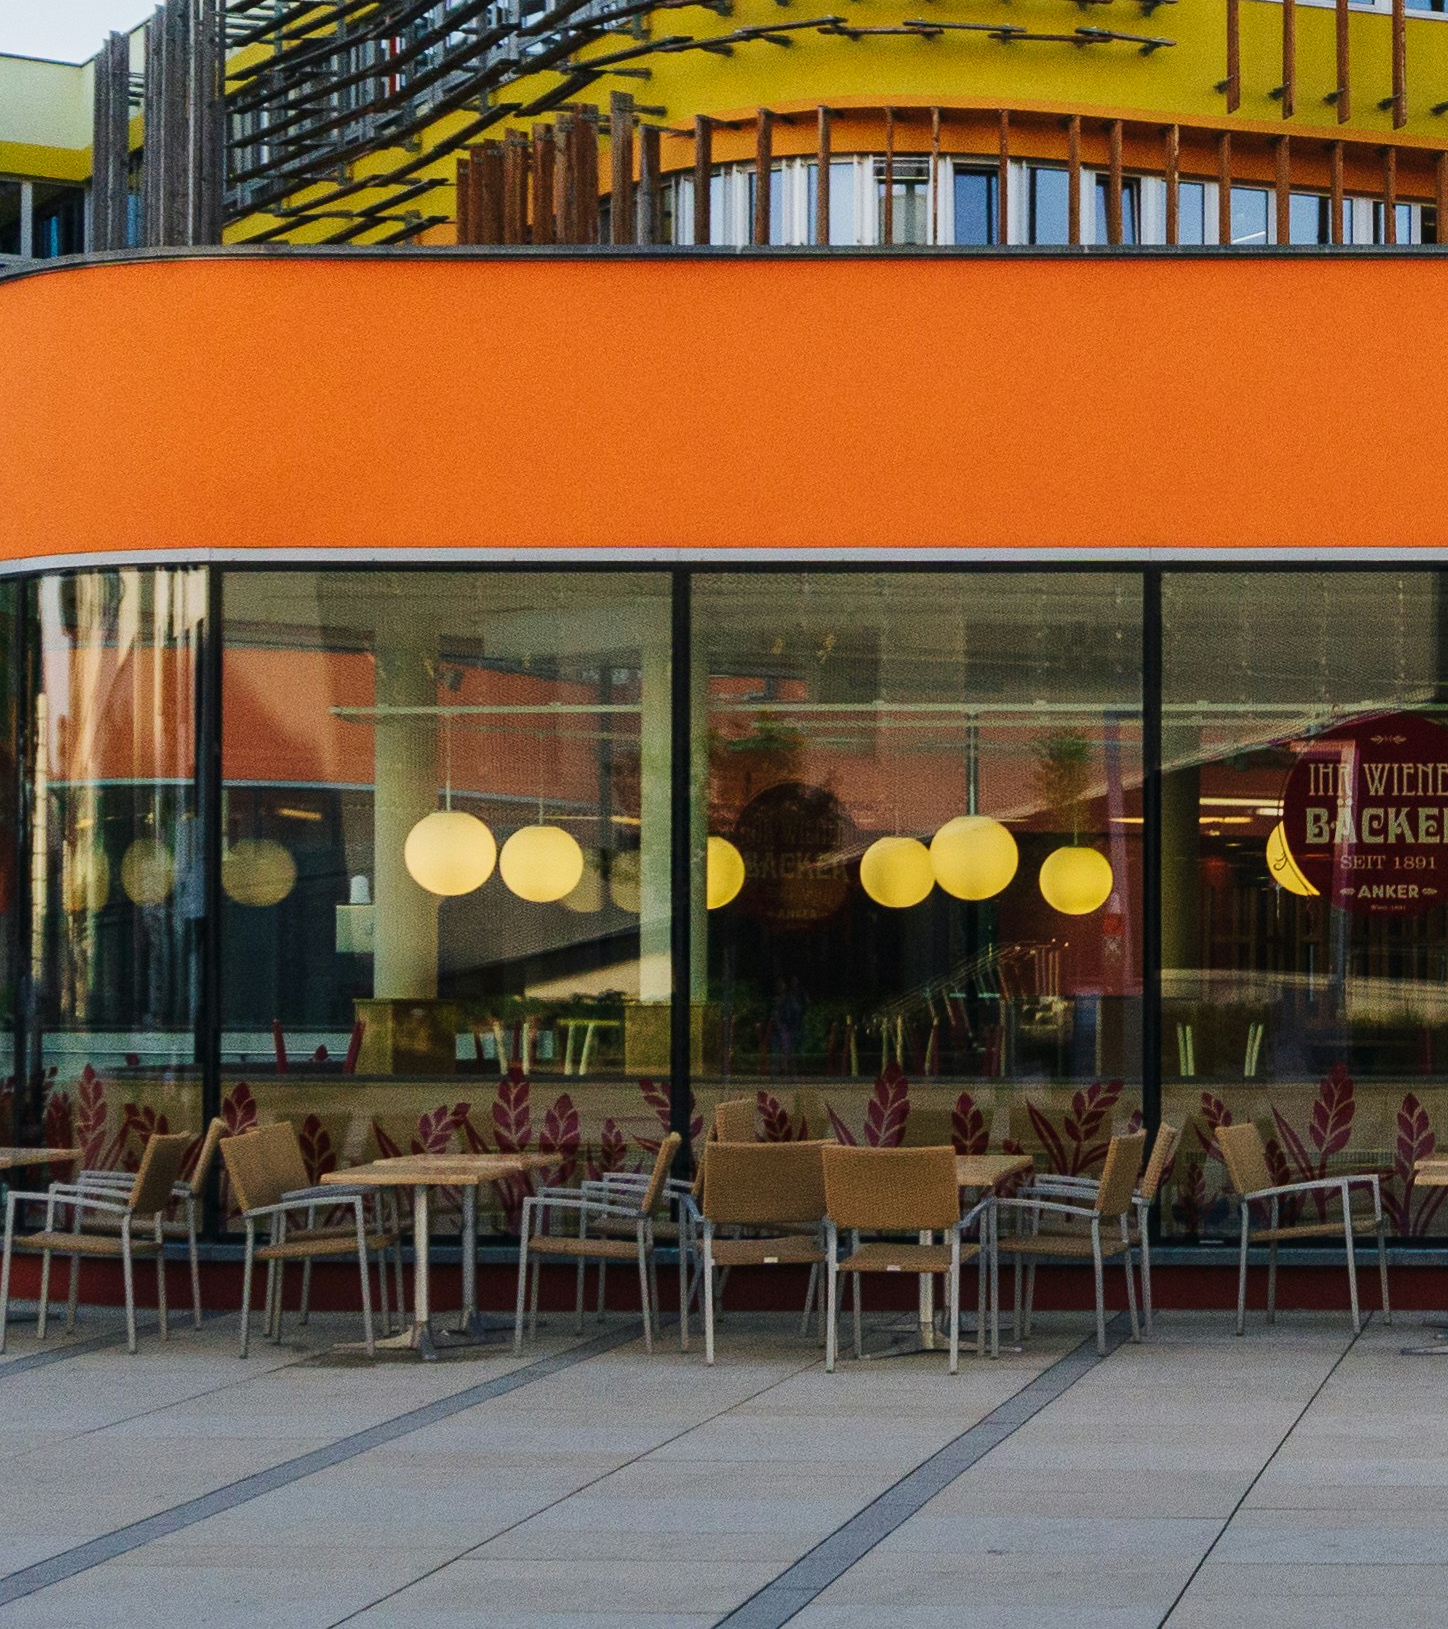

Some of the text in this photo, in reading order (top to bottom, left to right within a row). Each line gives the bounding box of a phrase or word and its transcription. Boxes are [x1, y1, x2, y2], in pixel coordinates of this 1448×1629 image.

[1309, 763, 1353, 797] IHR
[1340, 855, 1436, 870] SEIT 1891
[1357, 885, 1419, 899] ANKER
